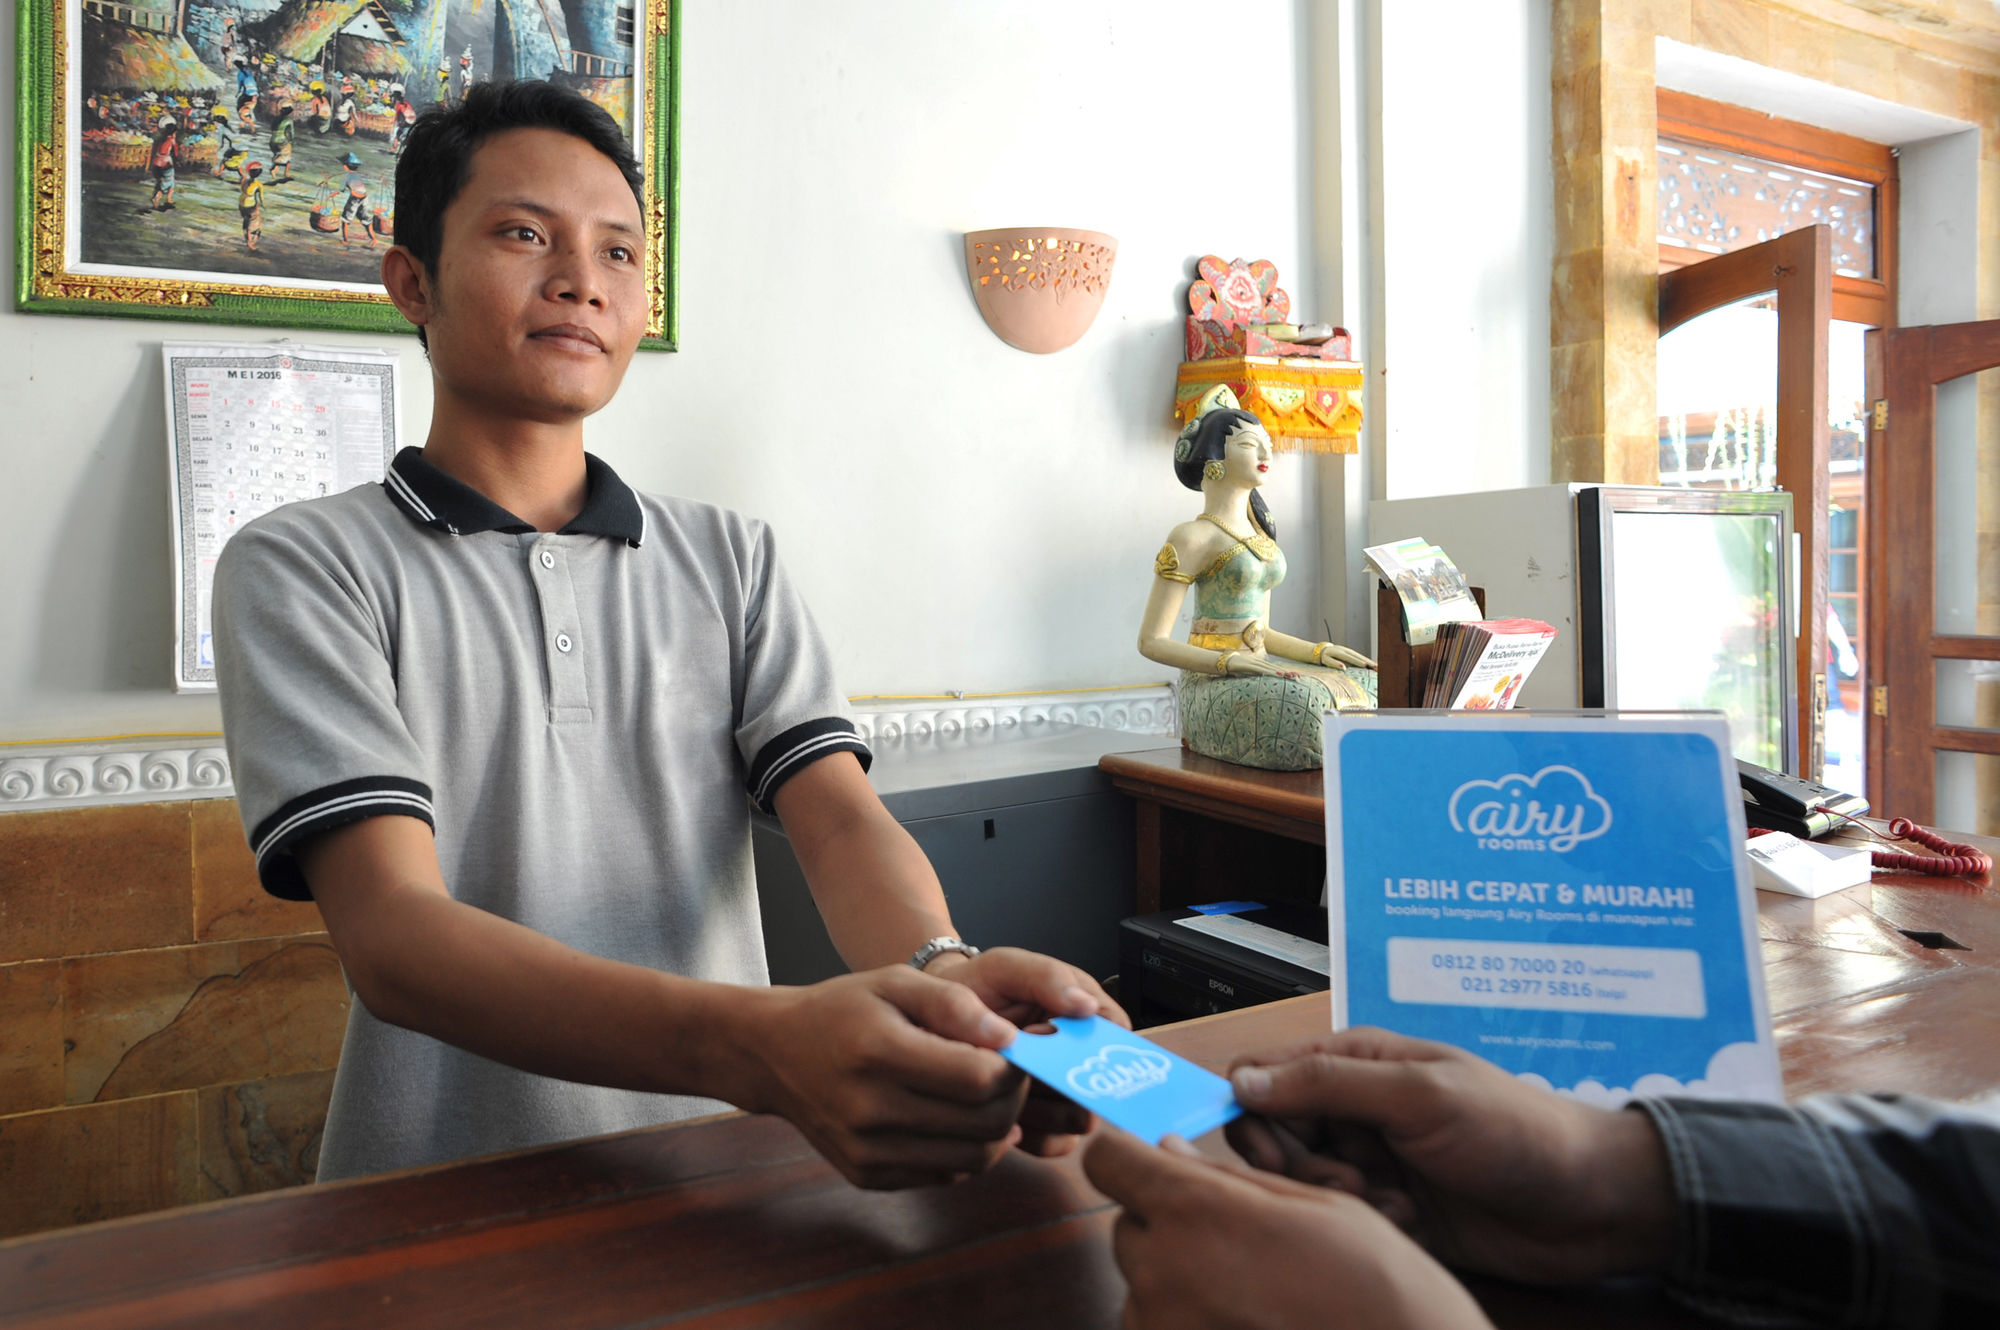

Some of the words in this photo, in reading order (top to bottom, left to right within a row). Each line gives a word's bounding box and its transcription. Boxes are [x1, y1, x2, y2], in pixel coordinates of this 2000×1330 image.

[227, 370, 254, 379] MEI
[256, 371, 282, 380] 2016
[271, 423, 281, 431] 16
[316, 429, 327, 437] 30
[226, 442, 232, 450] 3
[249, 444, 259, 452] 10
[295, 449, 304, 457] 24
[316, 452, 326, 460] 31
[250, 469, 258, 477] 11
[274, 471, 284, 479] 18
[296, 473, 306, 481] 25
[251, 493, 261, 501] 12
[274, 495, 284, 503] 19
[1468, 787, 1585, 853] airy
[1477, 838, 1547, 851] rooms
[1384, 877, 1460, 900] LEBIH
[1466, 880, 1550, 903] CEPAT
[1556, 883, 1576, 904] &
[1583, 884, 1695, 909] MURAH!
[1385, 904, 1440, 919] booking
[1442, 905, 1504, 922] langsung
[1507, 908, 1533, 923] Airy
[1535, 908, 1584, 922] Rooms
[1586, 910, 1600, 922] di
[1602, 912, 1669, 926] manapun
[1432, 953, 1476, 971] 0812
[1481, 955, 1505, 972] 80
[1511, 957, 1557, 974] 7000
[1562, 959, 1586, 975] 20
[1209, 979, 1234, 996] EPSON
[1461, 976, 1493, 993] 021
[1499, 978, 1542, 995] 2977
[1547, 980, 1592, 998] 5816
[1479, 1034, 1616, 1050] www.airyrooms.com
